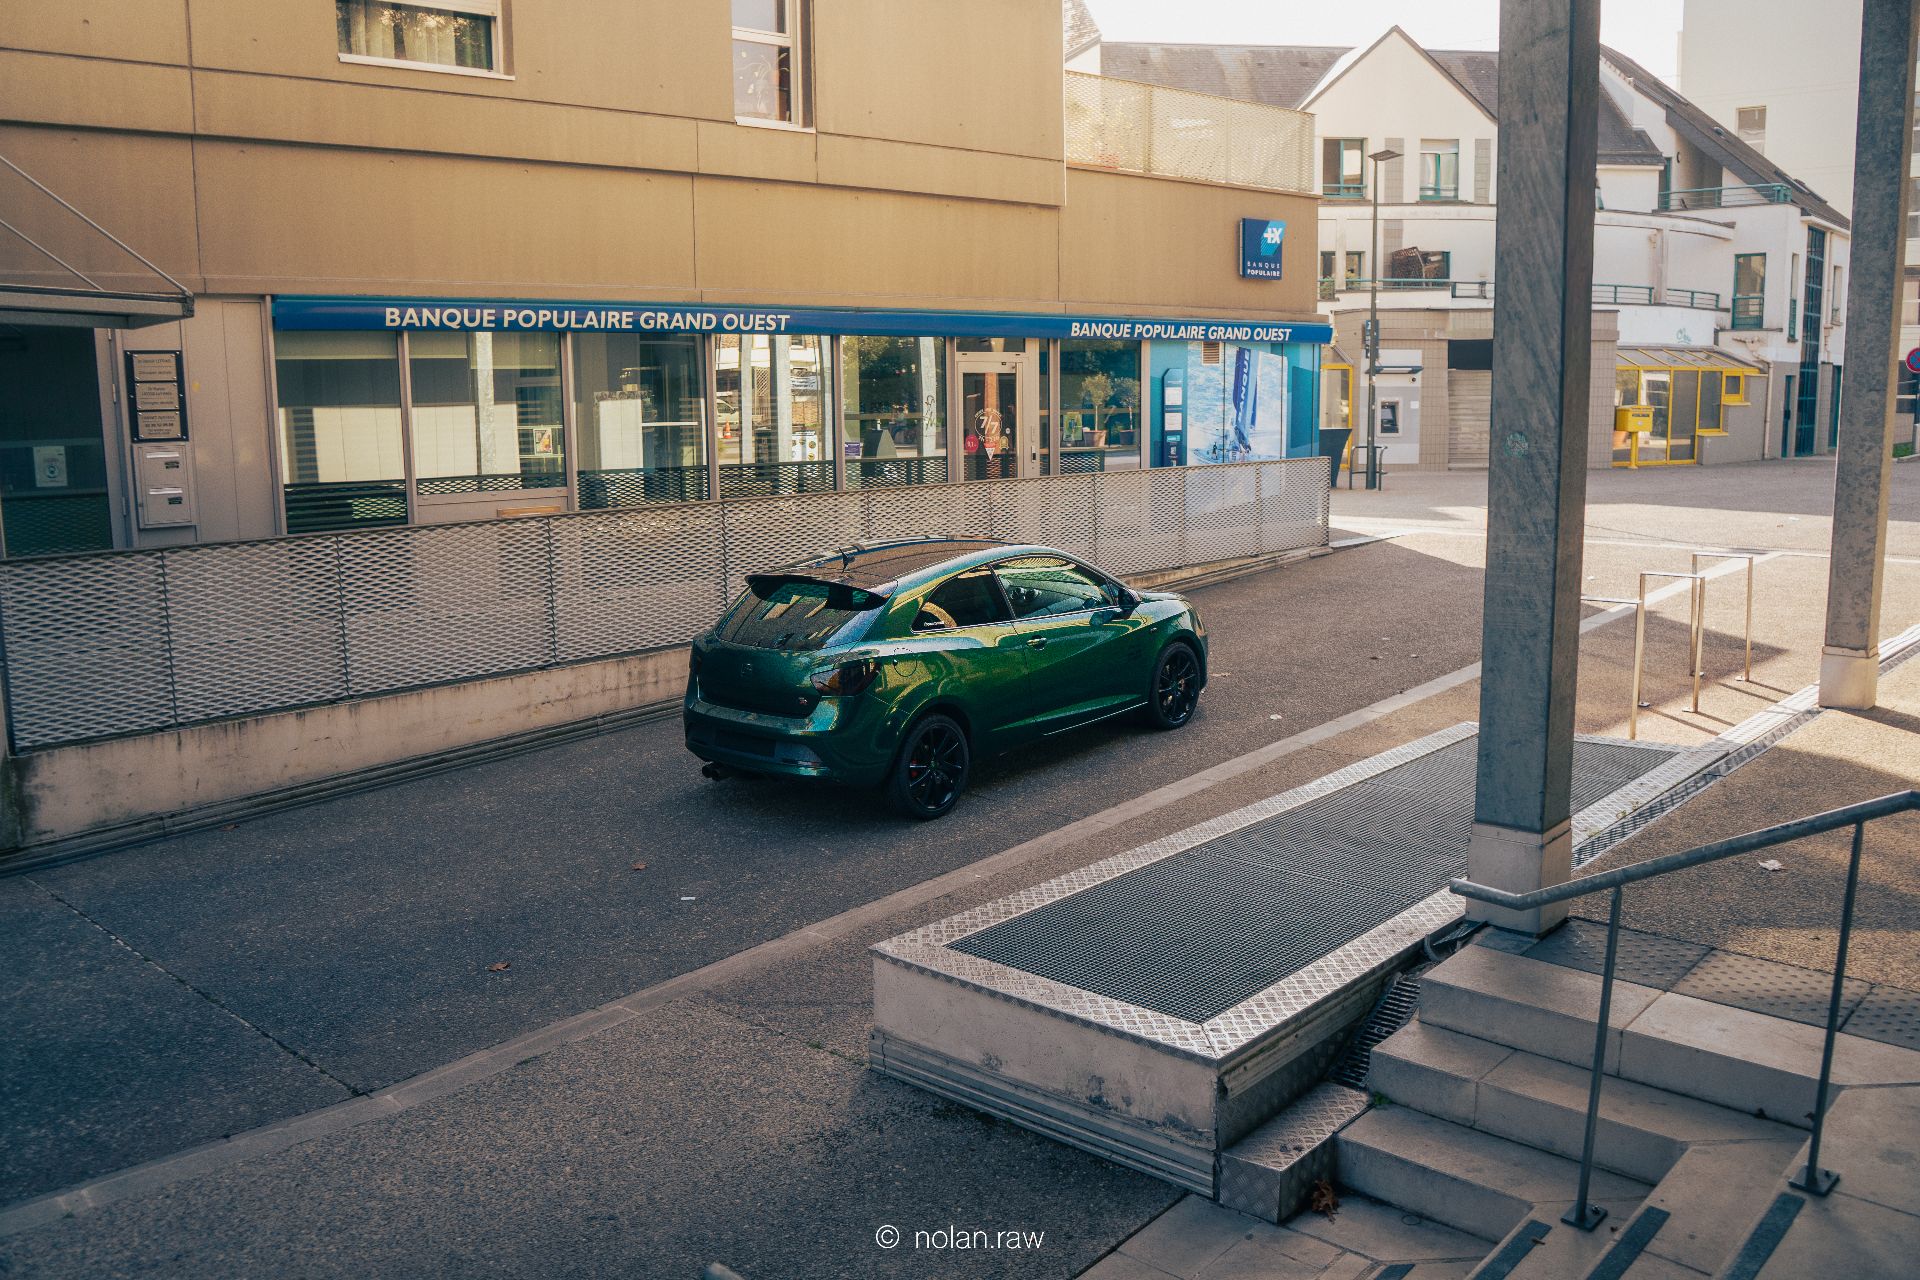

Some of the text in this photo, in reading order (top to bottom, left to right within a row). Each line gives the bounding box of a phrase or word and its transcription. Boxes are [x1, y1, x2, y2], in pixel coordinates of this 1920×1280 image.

[1247, 261, 1281, 269] BANQUE
[1247, 269, 1281, 277] POPULAIRE
[385, 307, 791, 331] BANQUE POPULAIRE GRAND OUEST
[1071, 322, 1292, 341] BANQUE POPULAIRE GRAND OUEST
[979, 415, 999, 434] 7/7
